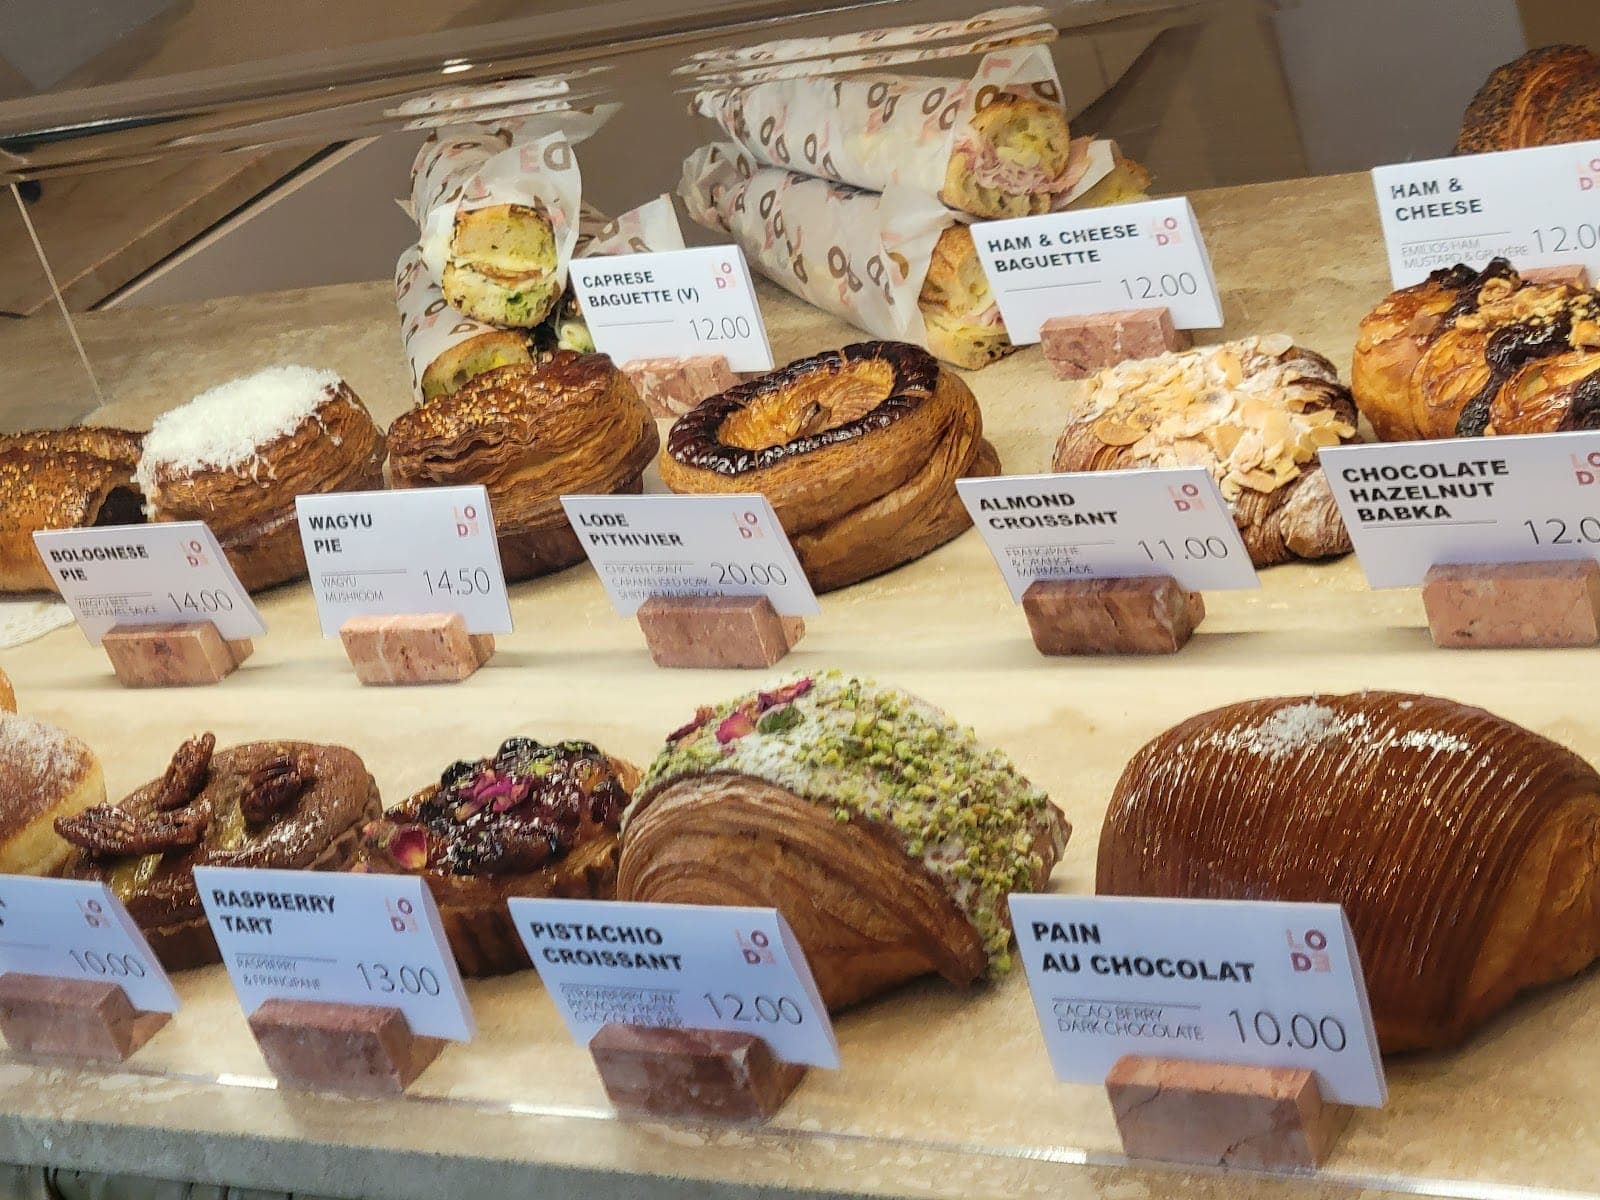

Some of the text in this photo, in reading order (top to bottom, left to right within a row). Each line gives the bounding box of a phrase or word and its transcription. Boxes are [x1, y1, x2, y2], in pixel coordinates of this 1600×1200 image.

[1391, 177, 1463, 199] HAM &
[1395, 199, 1483, 221] CHEESE
[988, 224, 1139, 253] HAM & CHEESE
[1452, 239, 1479, 250] HAM
[1533, 223, 1600, 253] 12.0
[995, 250, 1101, 273] BAGUETTE
[1403, 253, 1462, 269] MUSTARD
[582, 271, 655, 289] CAPRESE
[1120, 272, 1198, 300] 12.00
[588, 287, 699, 307] BAGUETTE (V)
[689, 316, 751, 342] 12.00
[1343, 460, 1509, 483] CHOCOLATE
[980, 493, 1075, 512] ALMOND
[1350, 483, 1496, 503] HAZELNUT
[308, 514, 373, 531] WAGYU
[579, 513, 629, 527] LODE
[988, 512, 1119, 530] CROISSANT
[1357, 505, 1452, 522] BABKA
[589, 534, 684, 546] PITHIVIER
[1523, 517, 1600, 545] 12.0
[50, 544, 149, 563] BOLOGNESE
[313, 538, 342, 554] PIE
[1138, 536, 1228, 561] 11.00
[59, 568, 88, 582] PIE
[321, 576, 357, 588] WAGYU
[423, 567, 490, 597] 14.50
[710, 562, 787, 586] 20.00
[168, 589, 233, 614] 14.00
[325, 591, 384, 604] MUSHROOM
[212, 889, 335, 913] RASPBERRY
[220, 915, 273, 935] TART
[530, 921, 664, 946] PISTACHIO
[1031, 921, 1101, 945] PAIN
[69, 950, 145, 977] 10.00
[542, 948, 682, 972] CROISSANT
[1042, 953, 1255, 984] AU CHOCOLAT
[356, 962, 441, 997] 13.00
[703, 991, 803, 1026] 12.00
[1057, 1016, 1205, 1040] DARK CHOCOLATE
[1229, 1008, 1347, 1052] 10.00
